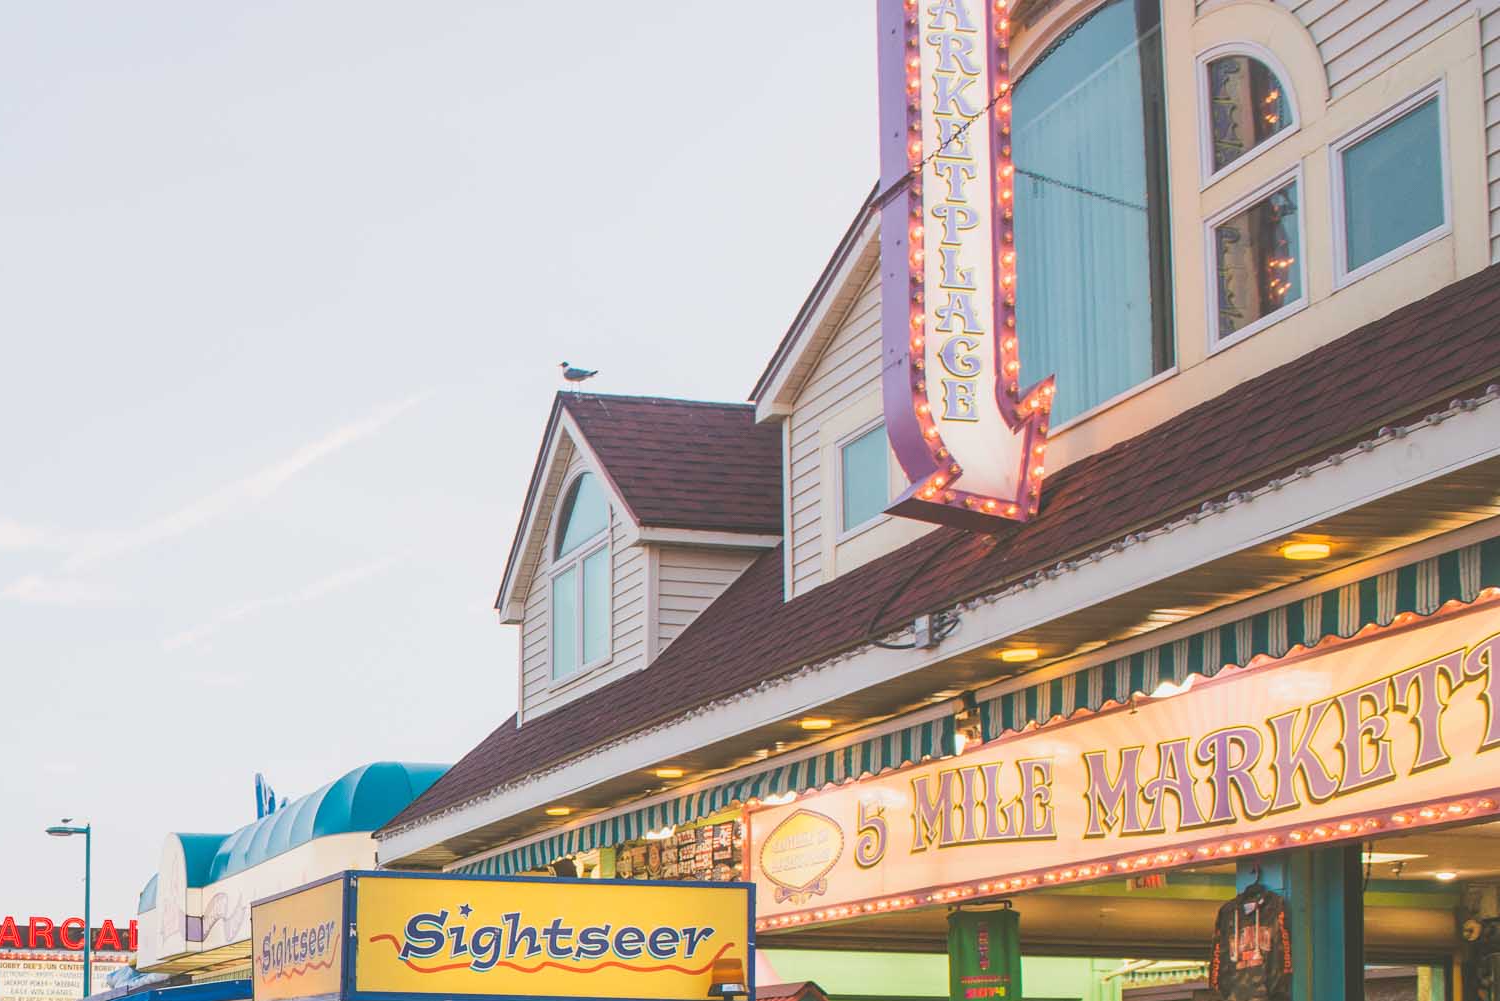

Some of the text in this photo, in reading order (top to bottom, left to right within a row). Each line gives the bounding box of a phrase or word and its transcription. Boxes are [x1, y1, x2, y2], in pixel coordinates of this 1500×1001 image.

[854, 798, 888, 870] 5
[911, 758, 1057, 854] MILE
[260, 918, 335, 978] Sightseer
[399, 903, 715, 973] Sightseer
